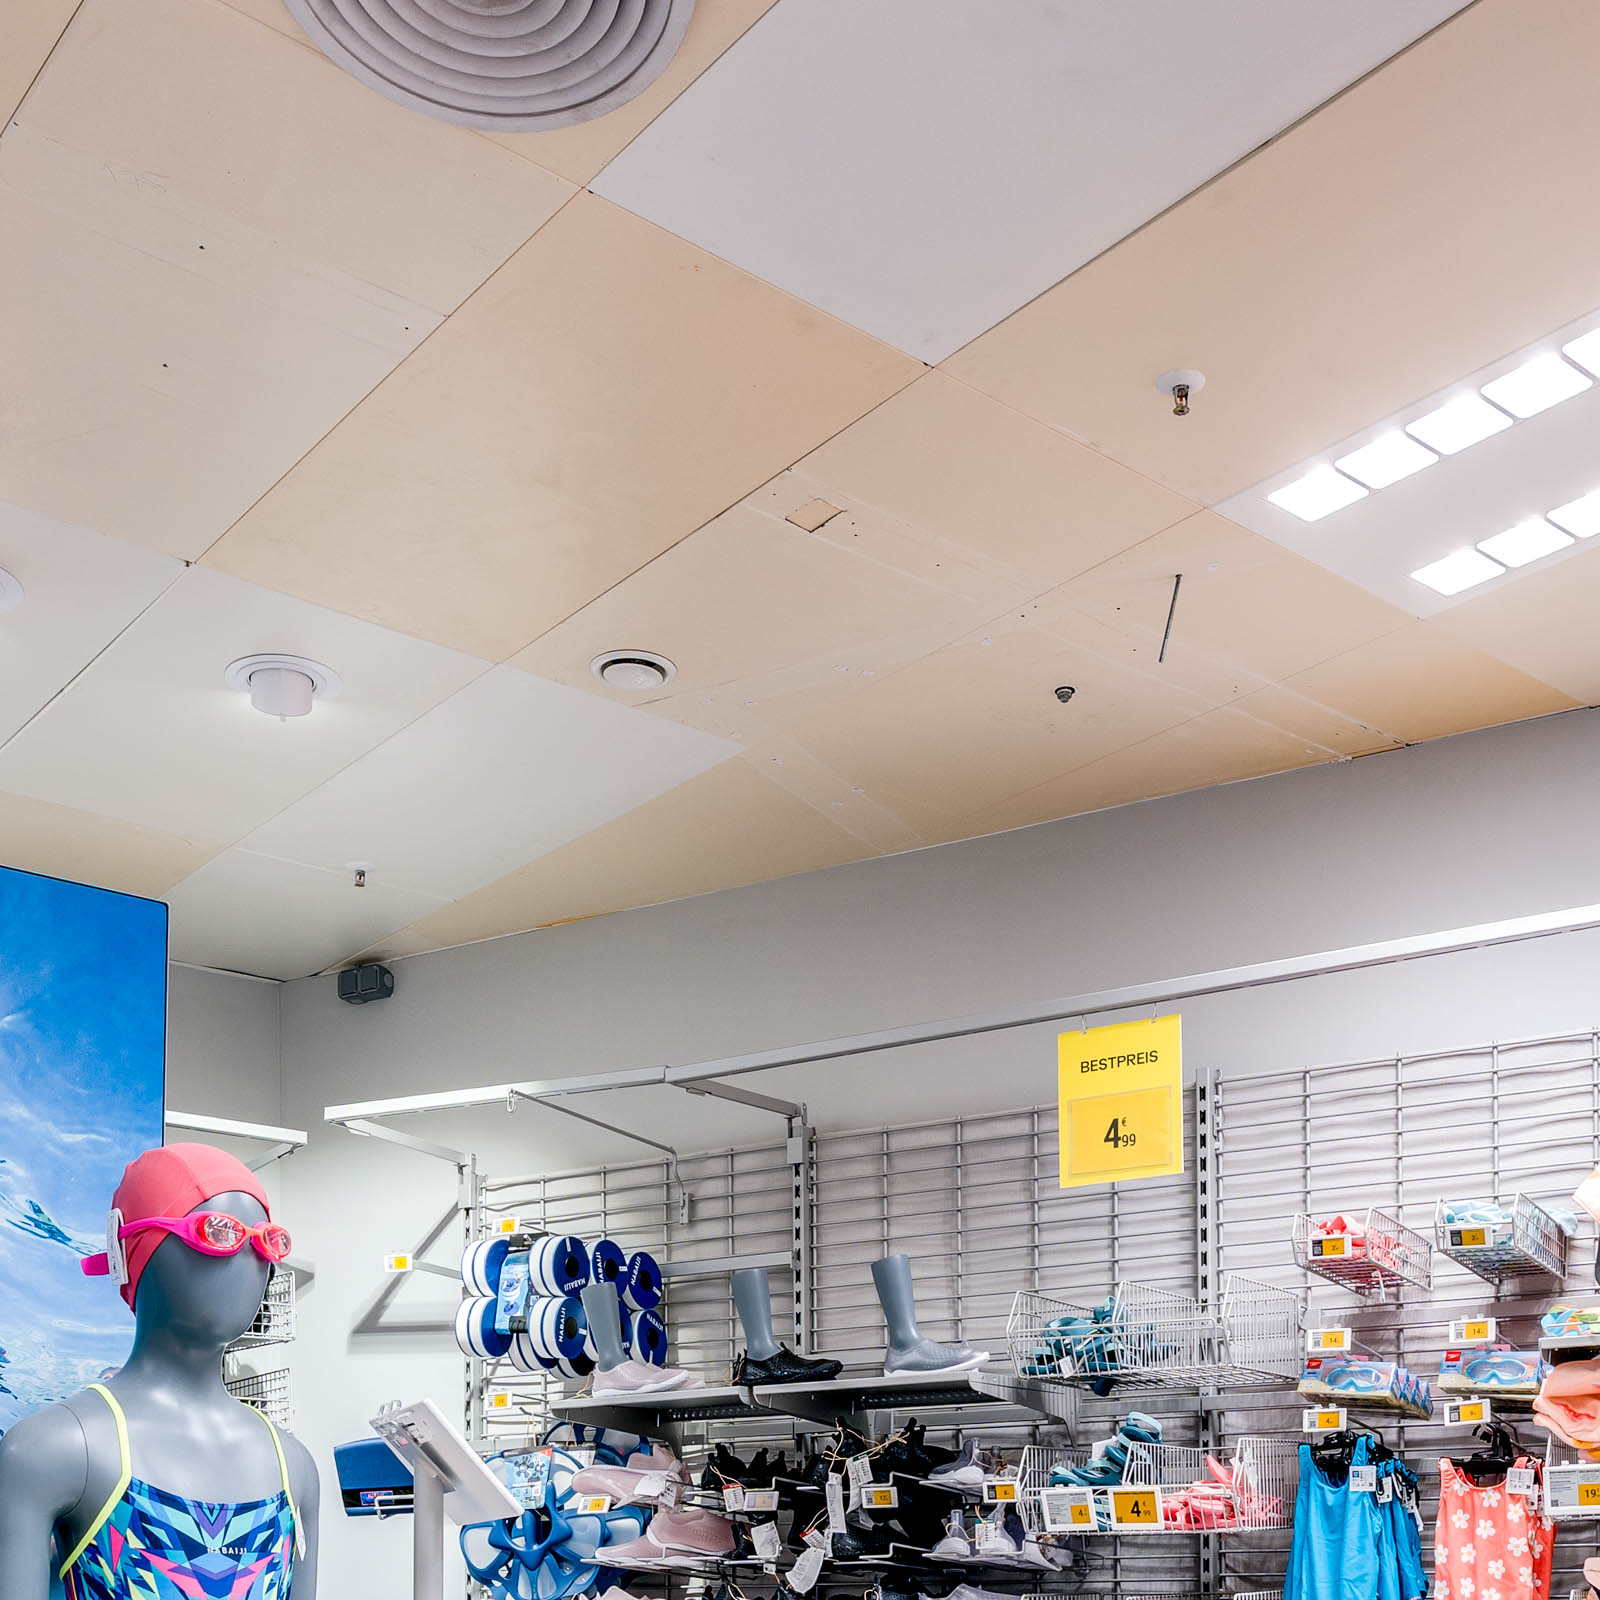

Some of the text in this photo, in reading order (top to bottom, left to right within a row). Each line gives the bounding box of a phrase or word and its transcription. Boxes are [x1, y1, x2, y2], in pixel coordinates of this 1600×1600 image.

[1080, 1050, 1159, 1074] BESTPREIS
[1103, 1118, 1122, 1149] 4
[1121, 1133, 1137, 1147] 99
[629, 1255, 643, 1287] NABAIJI
[558, 1307, 567, 1343] NABAIJI
[1584, 1488, 1598, 1498] 19
[1129, 1500, 1142, 1518] 4
